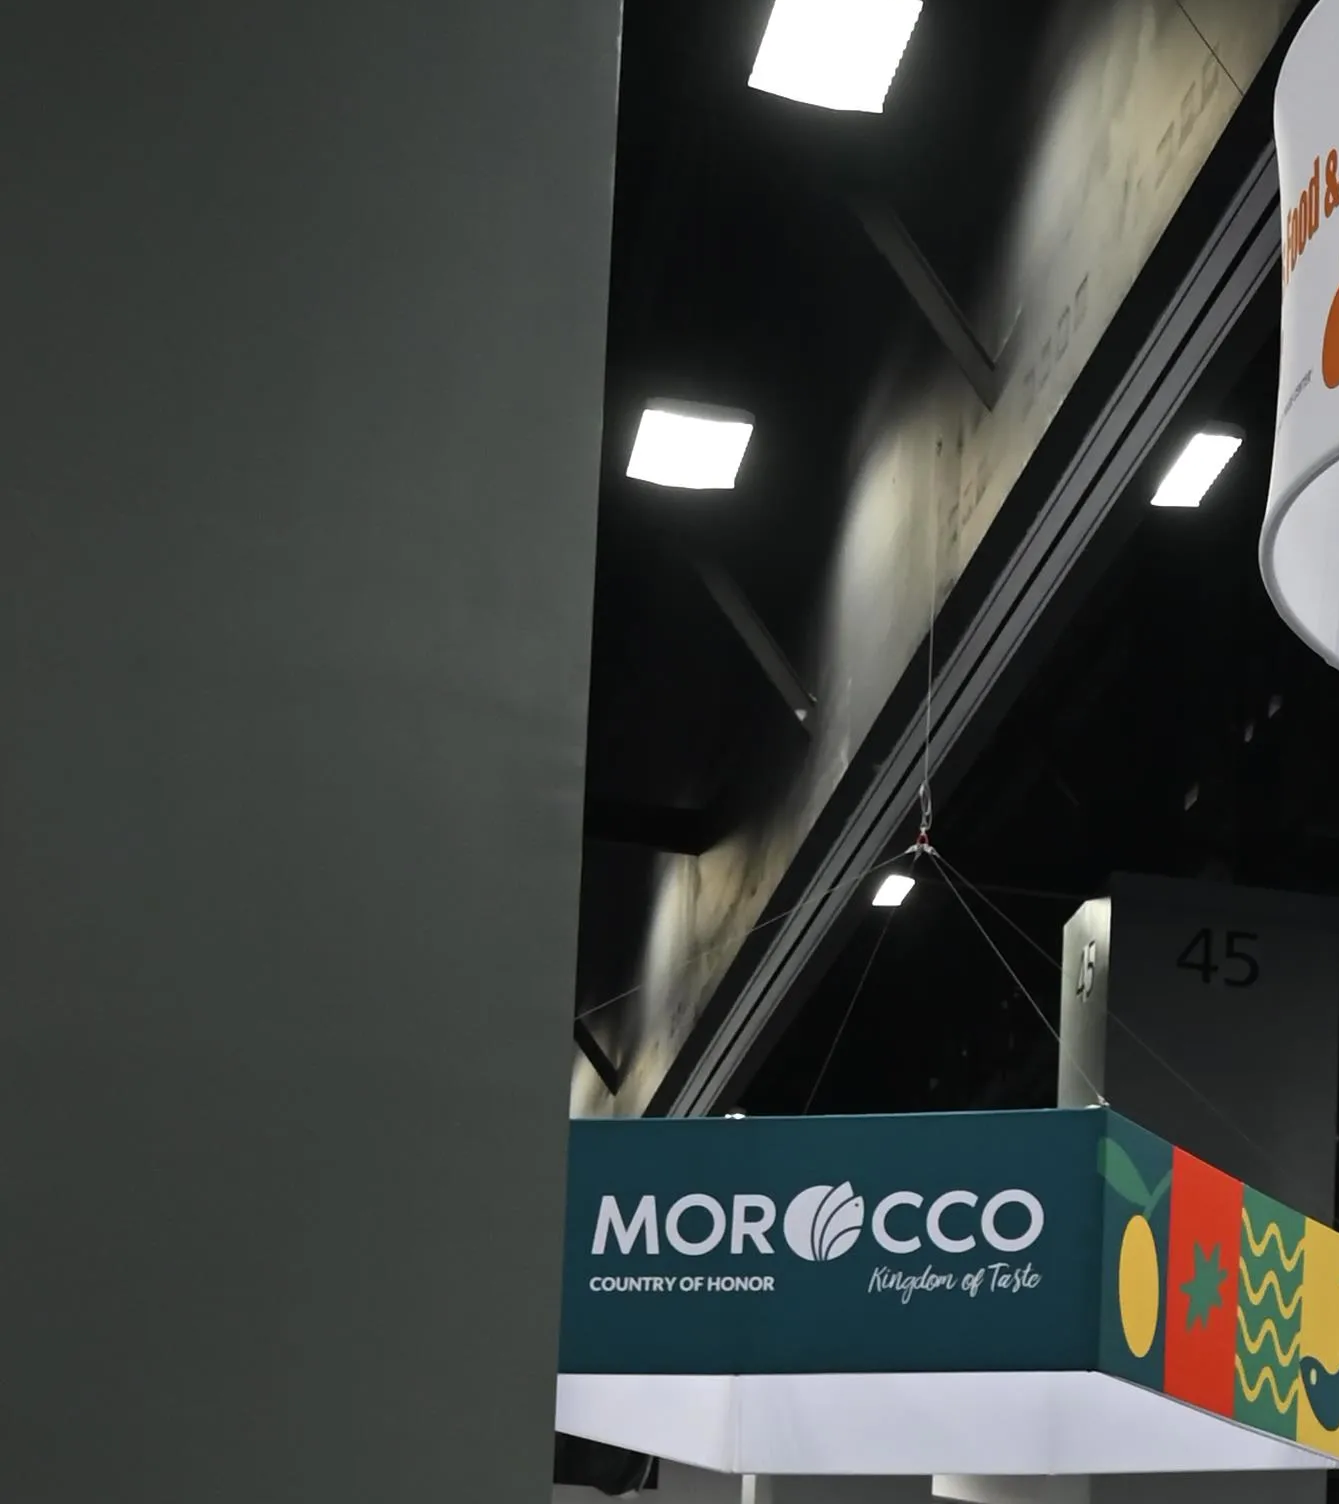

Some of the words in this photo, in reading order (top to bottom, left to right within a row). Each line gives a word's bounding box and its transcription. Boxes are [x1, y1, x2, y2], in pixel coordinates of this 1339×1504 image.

[1176, 928, 1260, 988] 45
[590, 1180, 1045, 1262] MOROCCO
[589, 1276, 677, 1292] COUNTRY
[679, 1276, 706, 1292] OF
[710, 1276, 775, 1292] HONOR
[867, 1265, 957, 1305] Kingdom
[962, 1266, 984, 1298] of
[987, 1262, 1042, 1293] Taste
